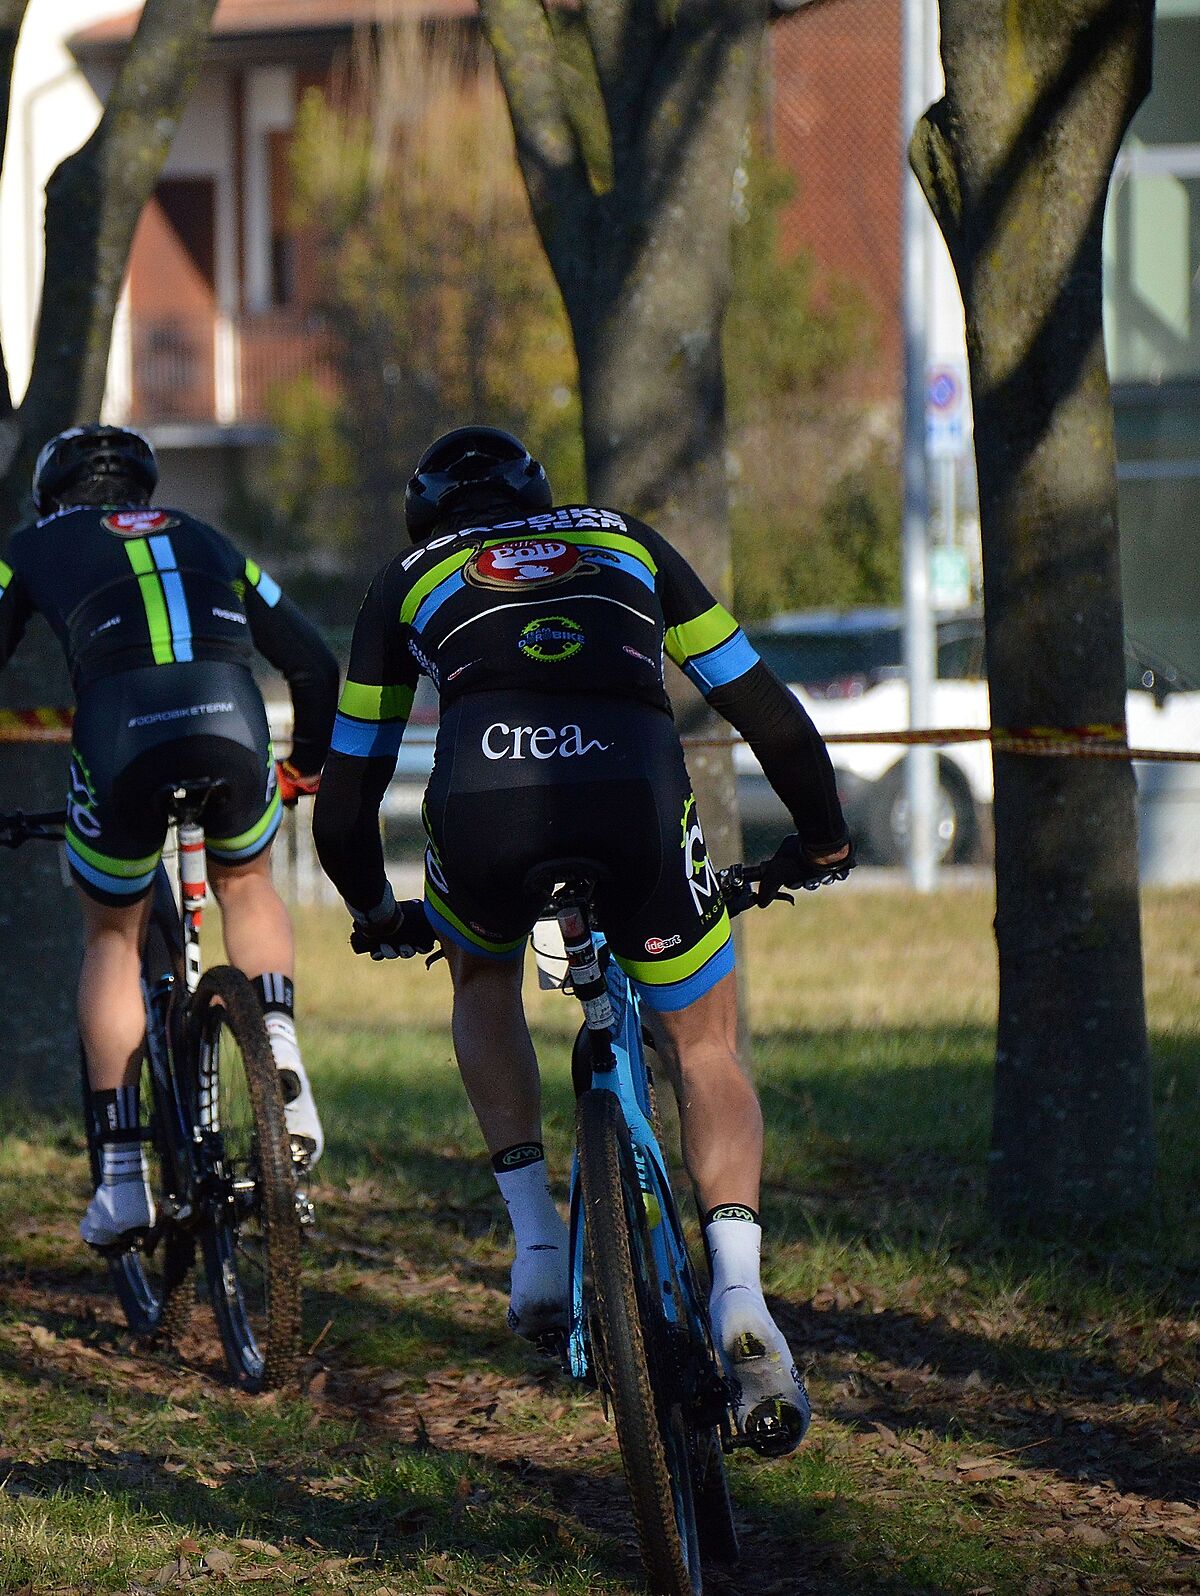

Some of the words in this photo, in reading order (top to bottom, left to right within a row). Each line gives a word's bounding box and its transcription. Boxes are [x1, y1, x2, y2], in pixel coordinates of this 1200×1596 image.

[529, 517, 628, 532] TEAM
[490, 543, 567, 569] Poli
[481, 722, 610, 760] crea
